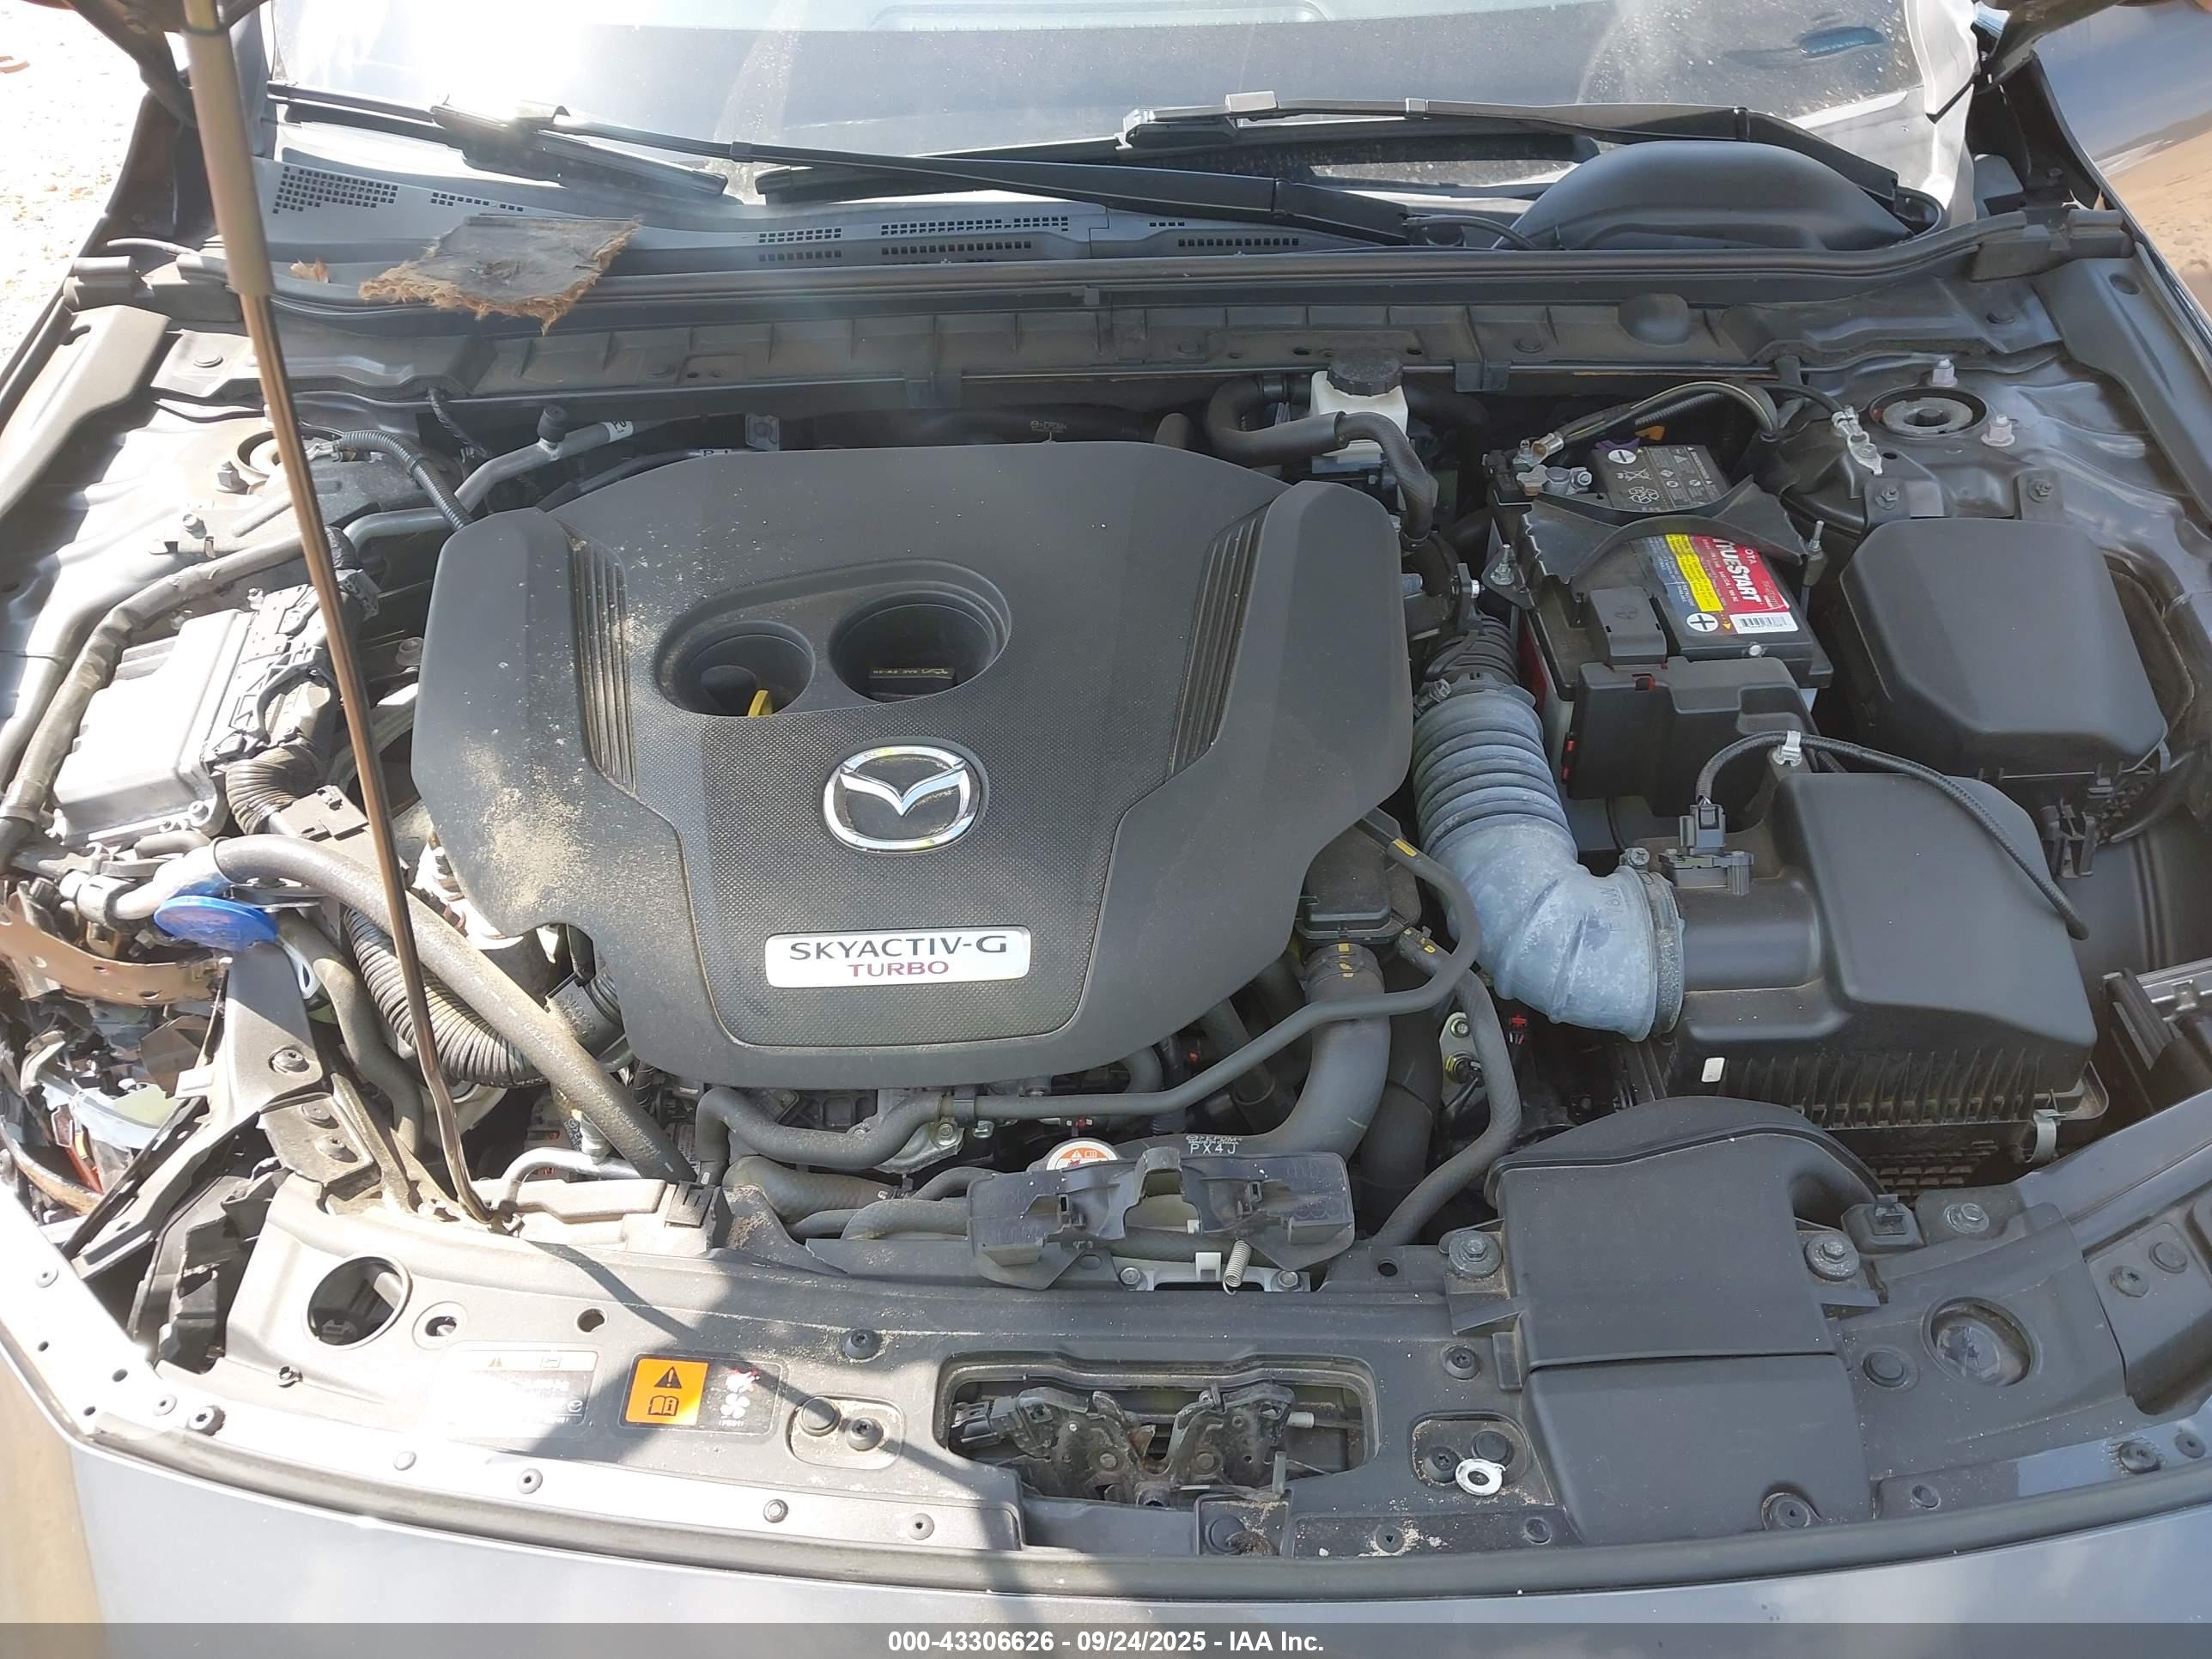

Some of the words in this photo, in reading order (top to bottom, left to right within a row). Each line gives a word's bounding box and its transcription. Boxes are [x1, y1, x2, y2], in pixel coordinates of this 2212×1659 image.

[789, 934, 1007, 961] SKYACTIV-G
[848, 960, 950, 977] TURBO
[523, 1021, 565, 1059] GALAXY
[1189, 1143, 1237, 1155] PX4J
